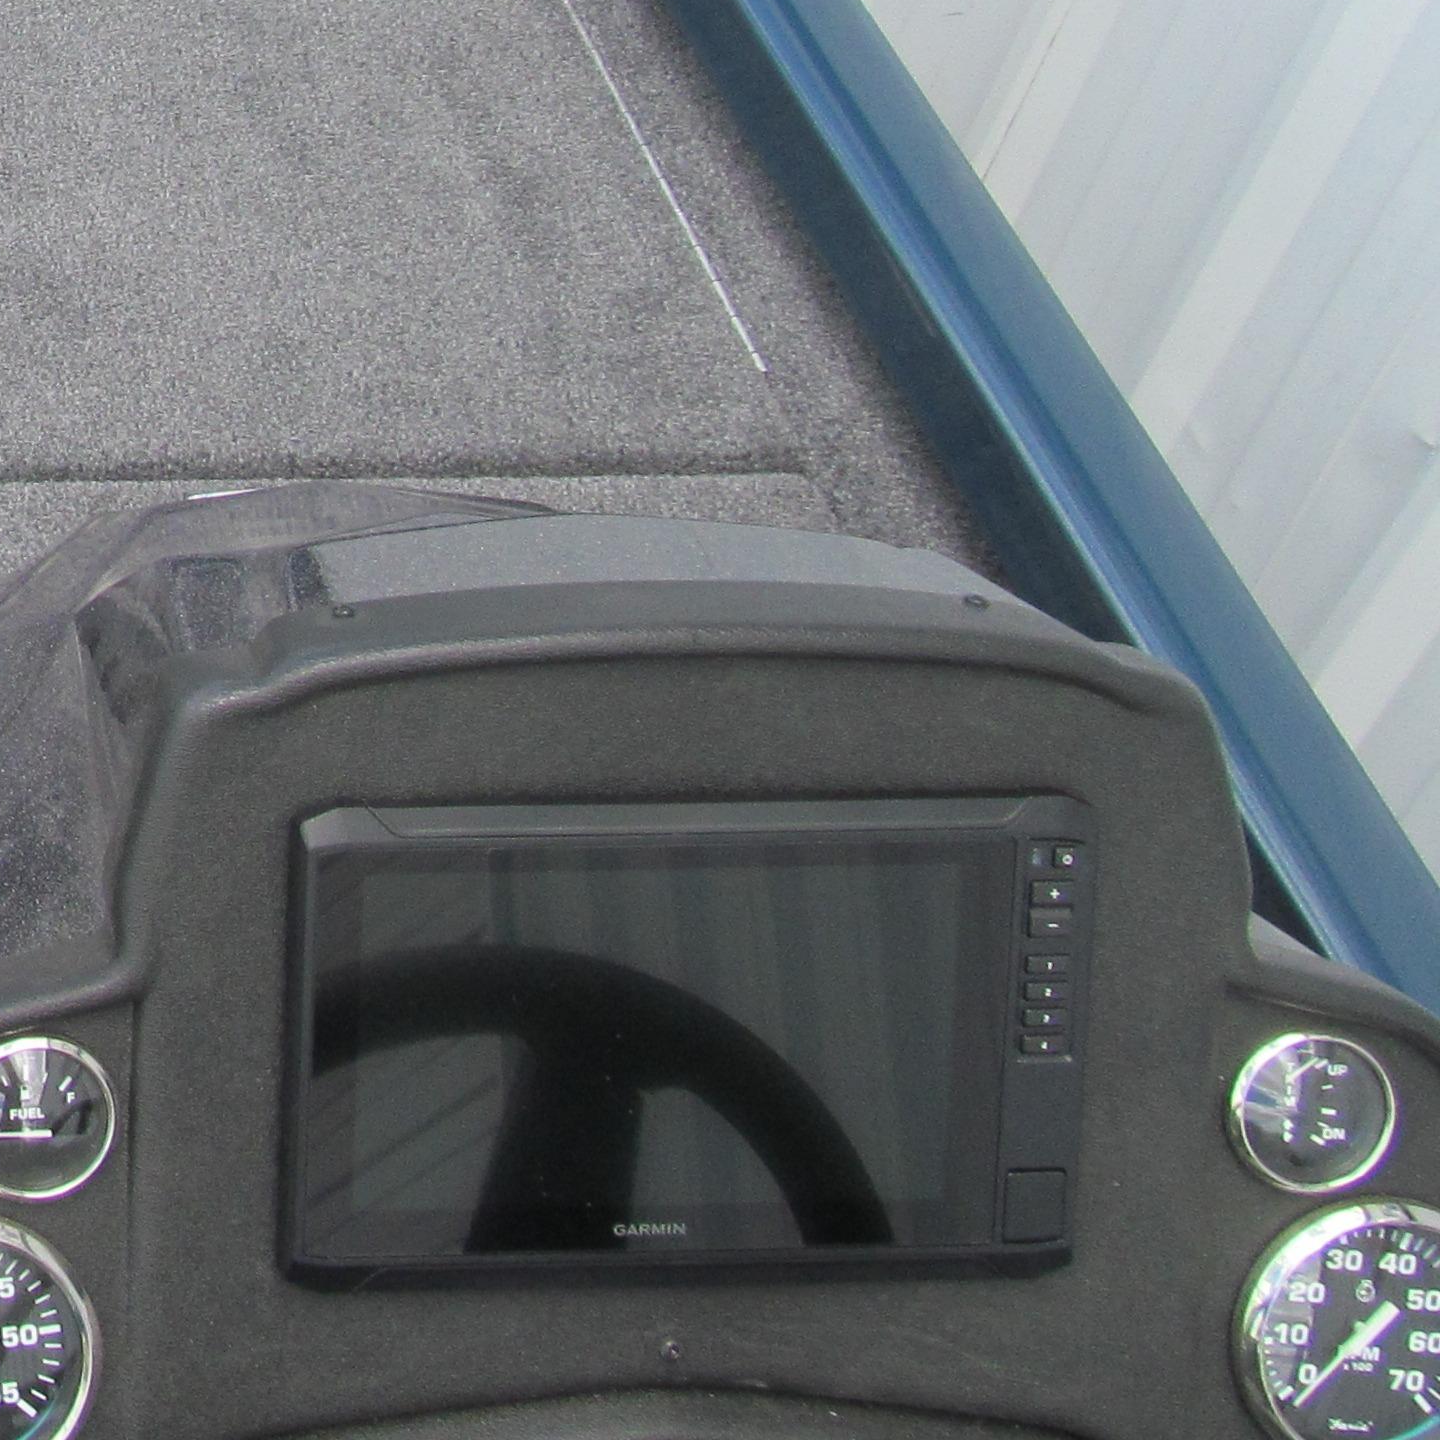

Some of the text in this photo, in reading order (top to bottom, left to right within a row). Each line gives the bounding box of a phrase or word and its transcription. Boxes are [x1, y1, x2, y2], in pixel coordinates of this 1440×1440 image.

[1327, 1064, 1348, 1076] UP
[66, 1092, 76, 1104] F
[9, 1107, 45, 1121] FUEL
[613, 1223, 687, 1236] GARMIN
[1325, 1249, 1363, 1271] 30
[1378, 1252, 1417, 1275] 40
[1288, 1282, 1326, 1303] 20
[1406, 1288, 1440, 1312] 50
[1, 1325, 39, 1348] 50
[1273, 1323, 1310, 1345] 10
[1409, 1331, 1440, 1354] 60
[1298, 1364, 1317, 1385] 0
[1388, 1369, 1424, 1392] 70
